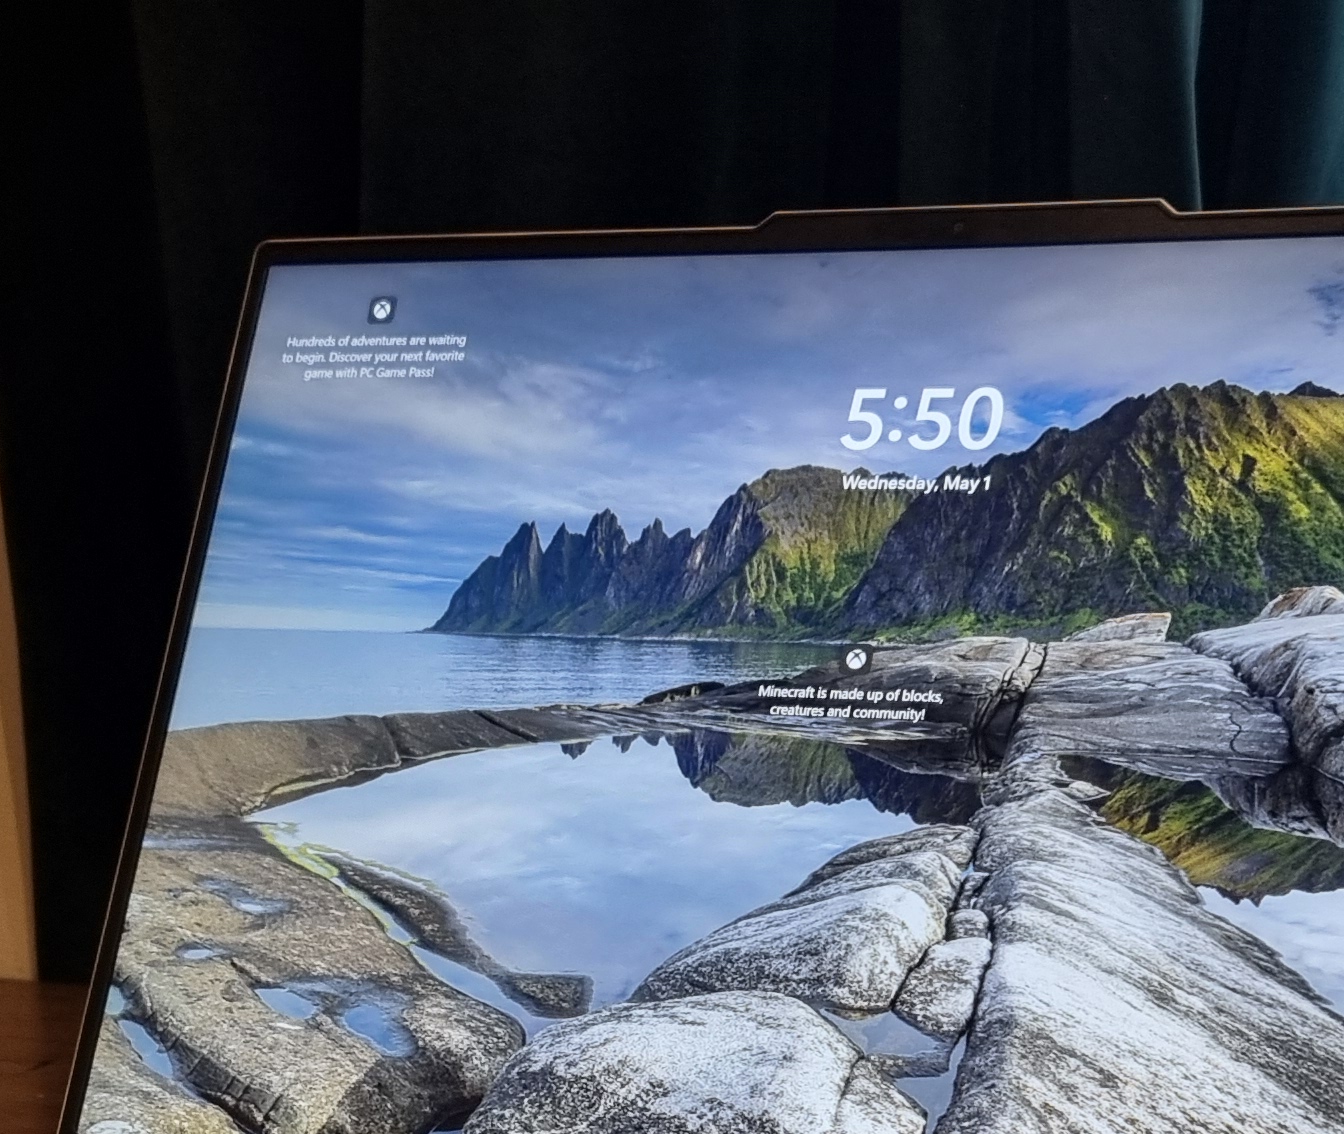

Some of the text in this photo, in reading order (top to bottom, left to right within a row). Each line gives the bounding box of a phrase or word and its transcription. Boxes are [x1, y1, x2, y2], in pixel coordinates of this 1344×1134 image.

[286, 334, 467, 348] Hundreds of adventures are waiting
[282, 350, 466, 366] to begin. Discover your next favorite
[304, 366, 435, 381] game with PC Game Pass!
[839, 386, 1004, 450] 5:50
[842, 475, 992, 495] Wednesday, May 1
[758, 684, 945, 705] Minecraft is made up of blocks,
[769, 705, 926, 724] creatures and community!
